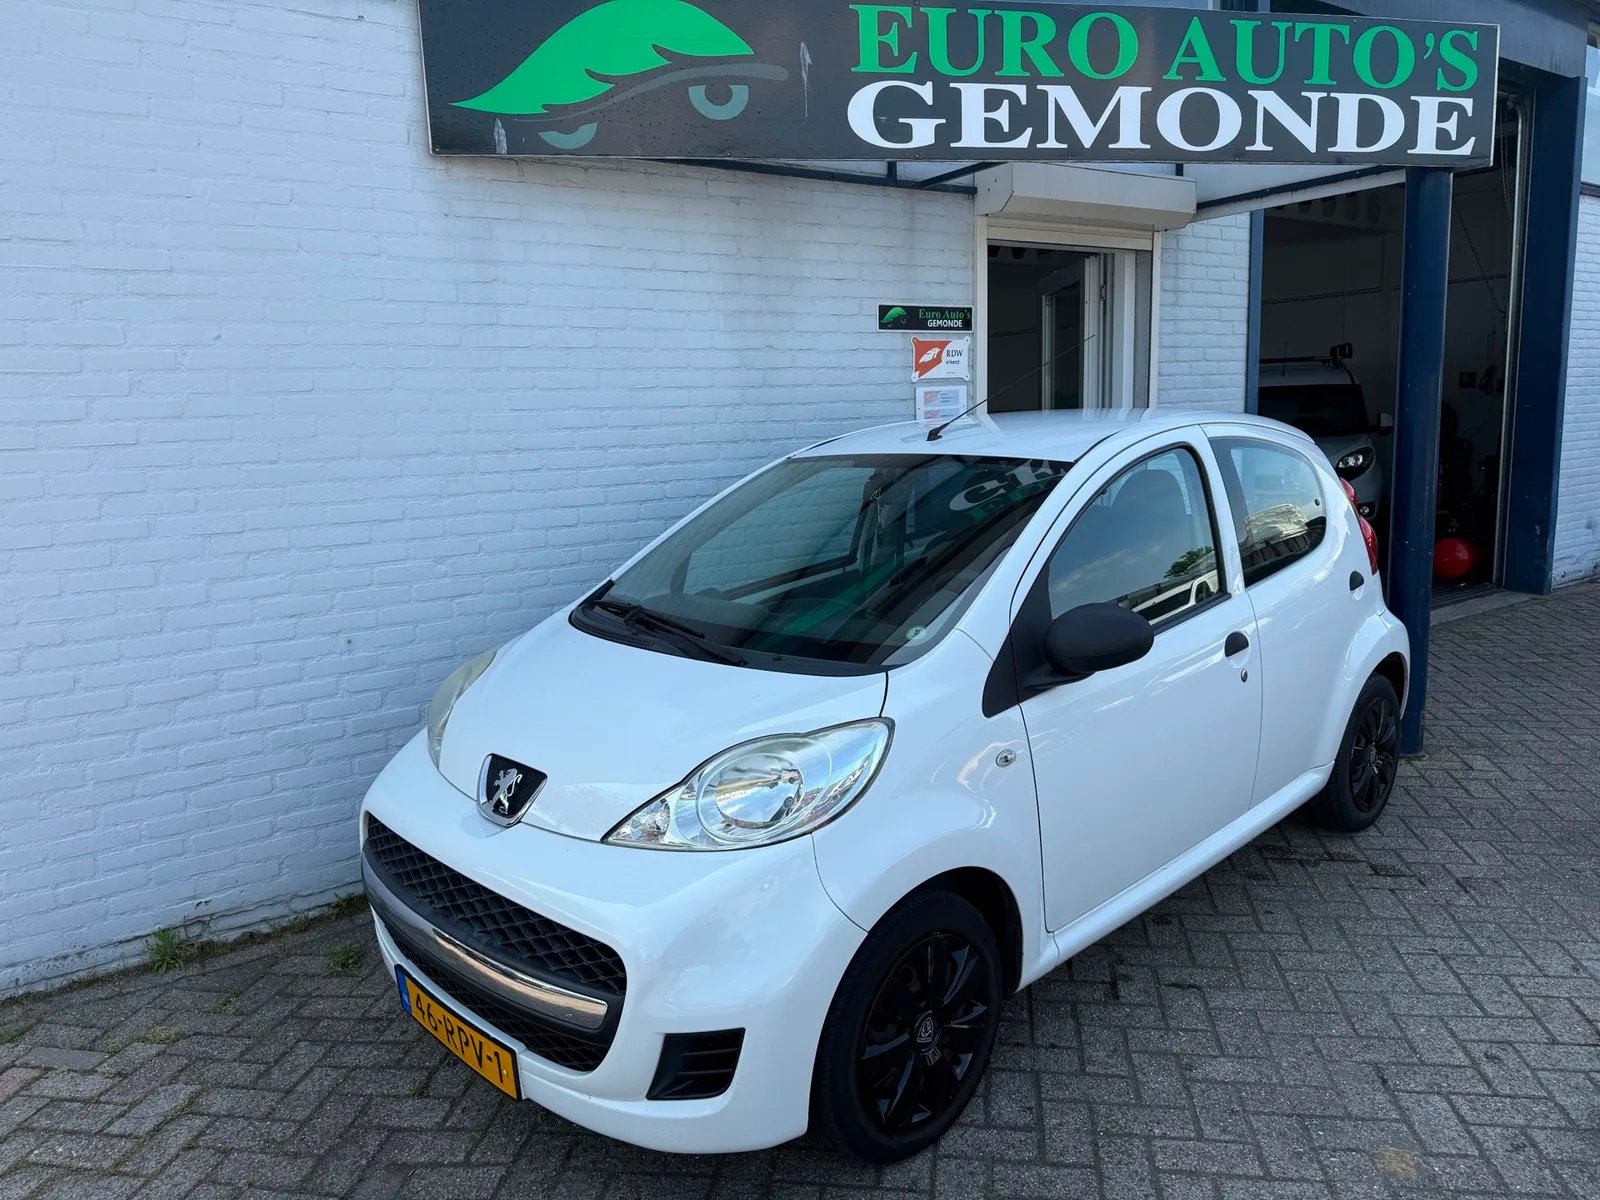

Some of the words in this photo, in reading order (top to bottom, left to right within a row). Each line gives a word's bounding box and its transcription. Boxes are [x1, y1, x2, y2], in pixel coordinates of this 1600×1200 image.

[850, 4, 1139, 79] EURO
[1163, 16, 1478, 92] AUTO'S
[847, 80, 1476, 155] GEMONDE
[918, 308, 941, 319] Euro
[943, 309, 971, 320] Auto's
[927, 319, 963, 328] GEMONDE
[946, 349, 964, 358] RDW
[415, 993, 504, 1084] 46-RPV-1
